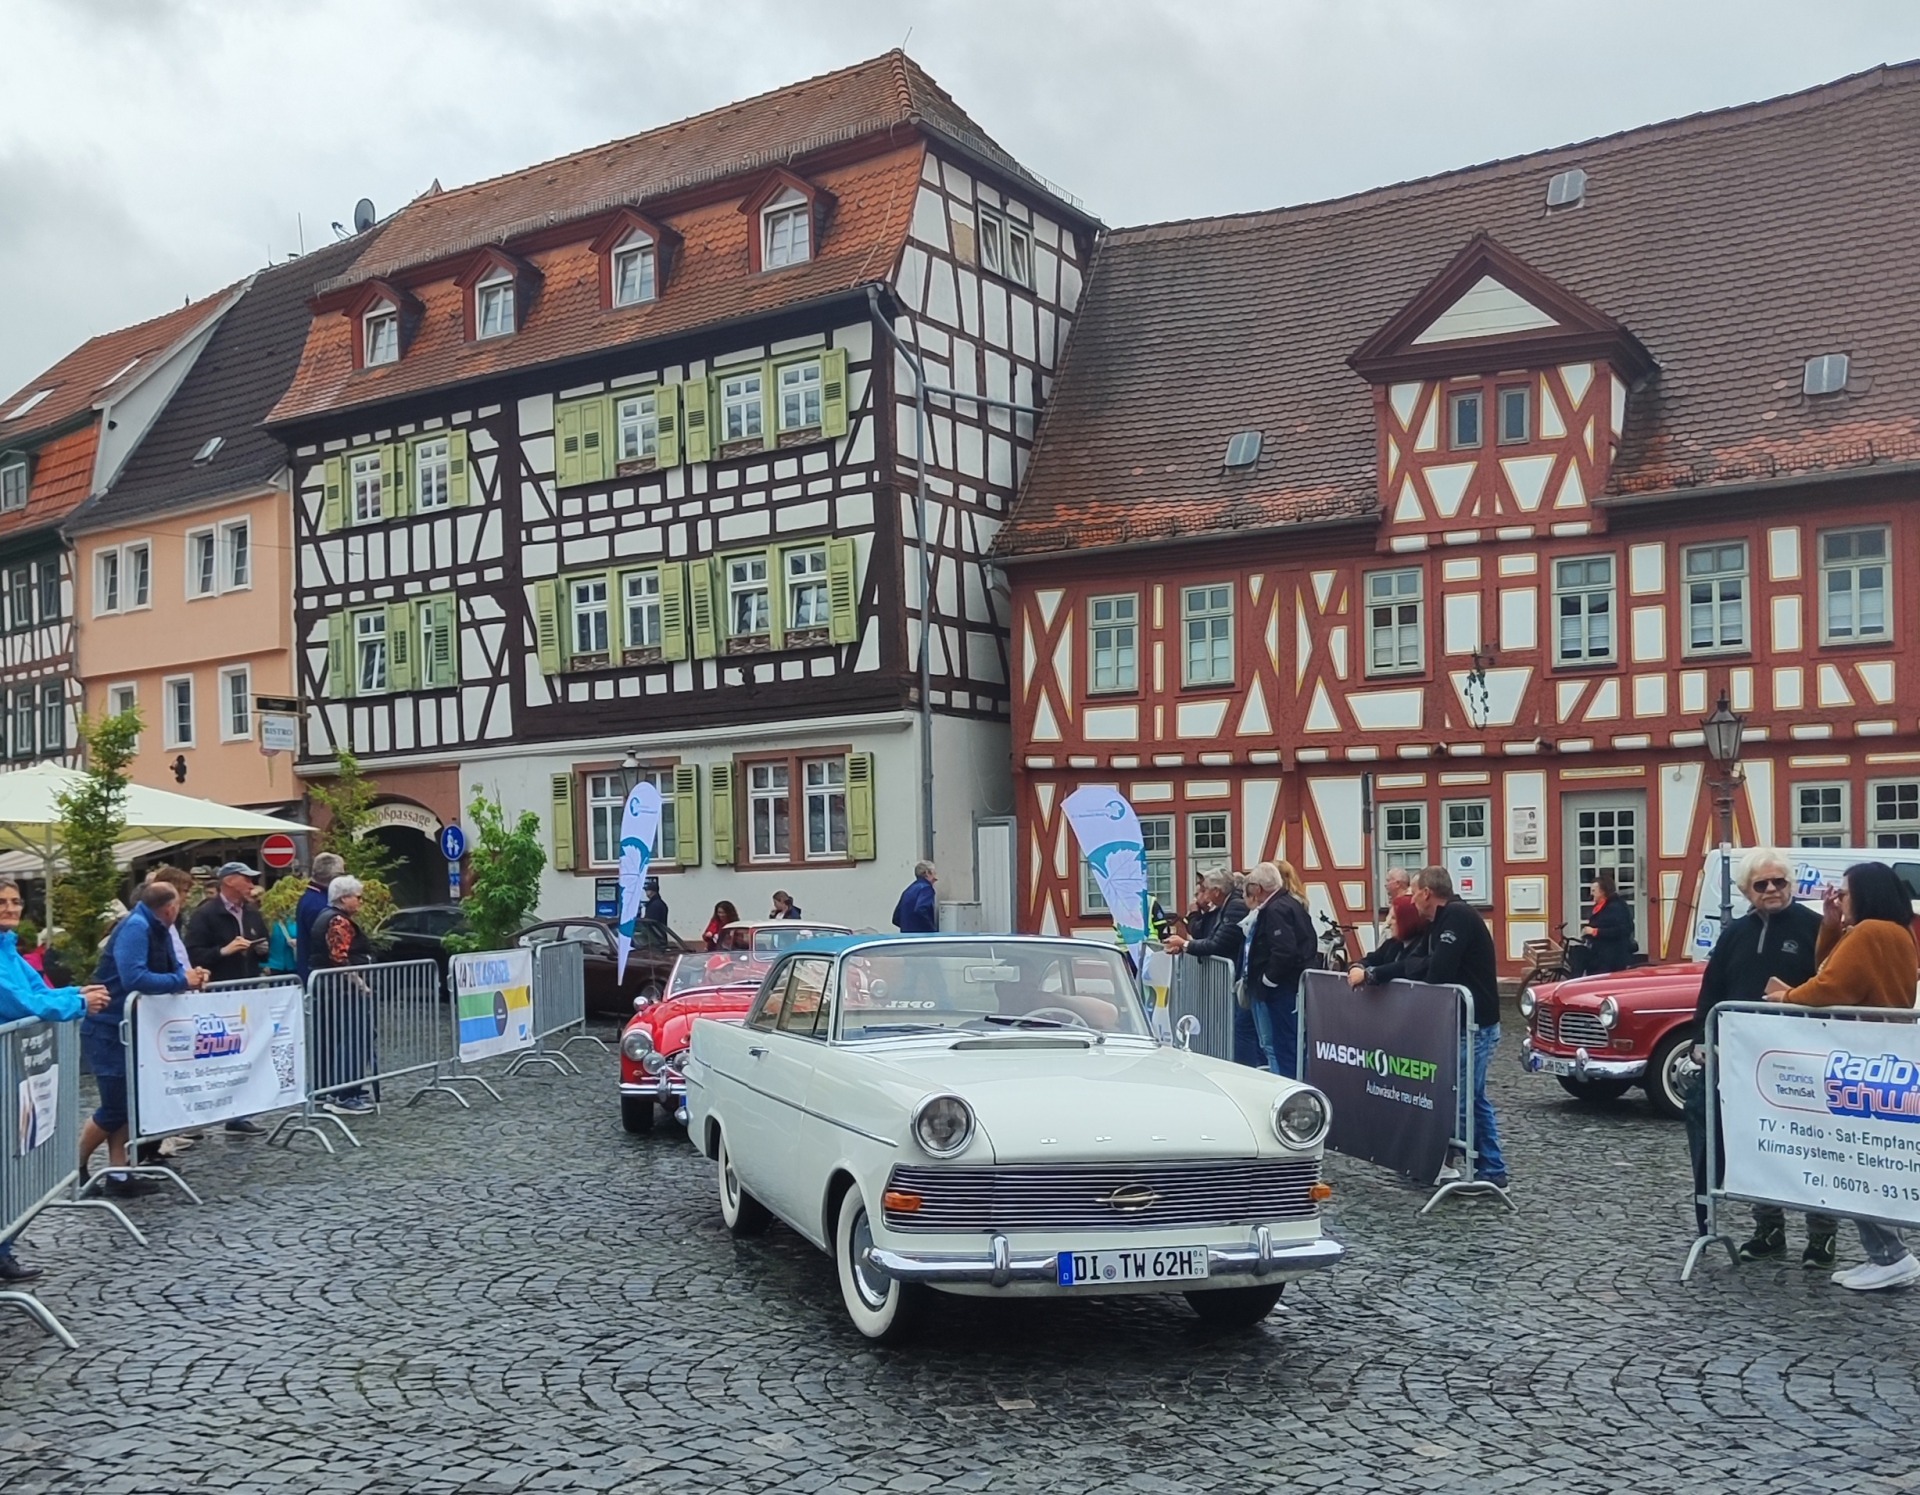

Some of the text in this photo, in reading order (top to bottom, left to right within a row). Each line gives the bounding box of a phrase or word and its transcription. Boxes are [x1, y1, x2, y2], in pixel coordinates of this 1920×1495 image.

[377, 806, 431, 827] oßpassage
[1316, 1041, 1437, 1083] WASCHKONZEPT
[1825, 1050, 1916, 1086] Radio
[1775, 1084, 1816, 1099] TechniSat
[1759, 1119, 1777, 1132] TV
[1790, 1122, 1824, 1138] Radio
[1758, 1138, 1846, 1163] Klimasysteme
[1803, 1172, 1828, 1187] Tel.
[1833, 1176, 1870, 1194] 06078
[1882, 1184, 1898, 1199] 93
[1902, 1187, 1920, 1201] 15
[1074, 1250, 1192, 1280] DI TW 62H
